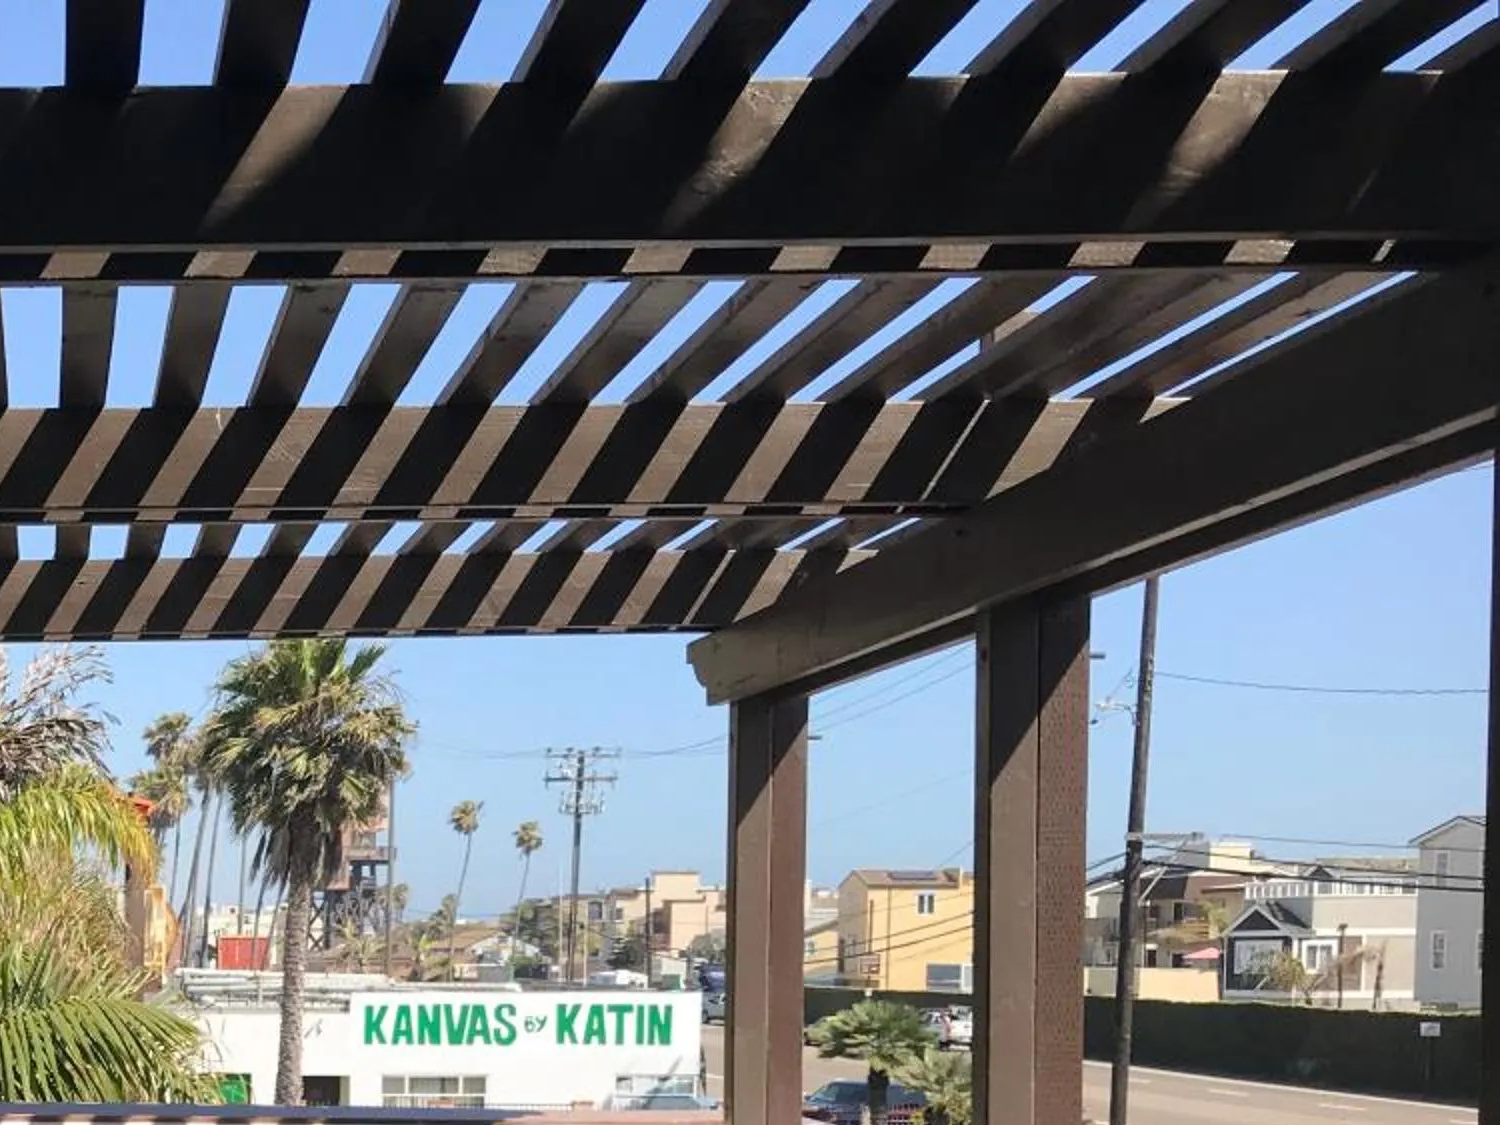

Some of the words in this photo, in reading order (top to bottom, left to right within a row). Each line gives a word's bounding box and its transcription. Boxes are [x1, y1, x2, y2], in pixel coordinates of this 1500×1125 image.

[363, 1003, 518, 1046] KANVAS
[523, 1014, 548, 1033] BY
[555, 1003, 673, 1045] KATIN
